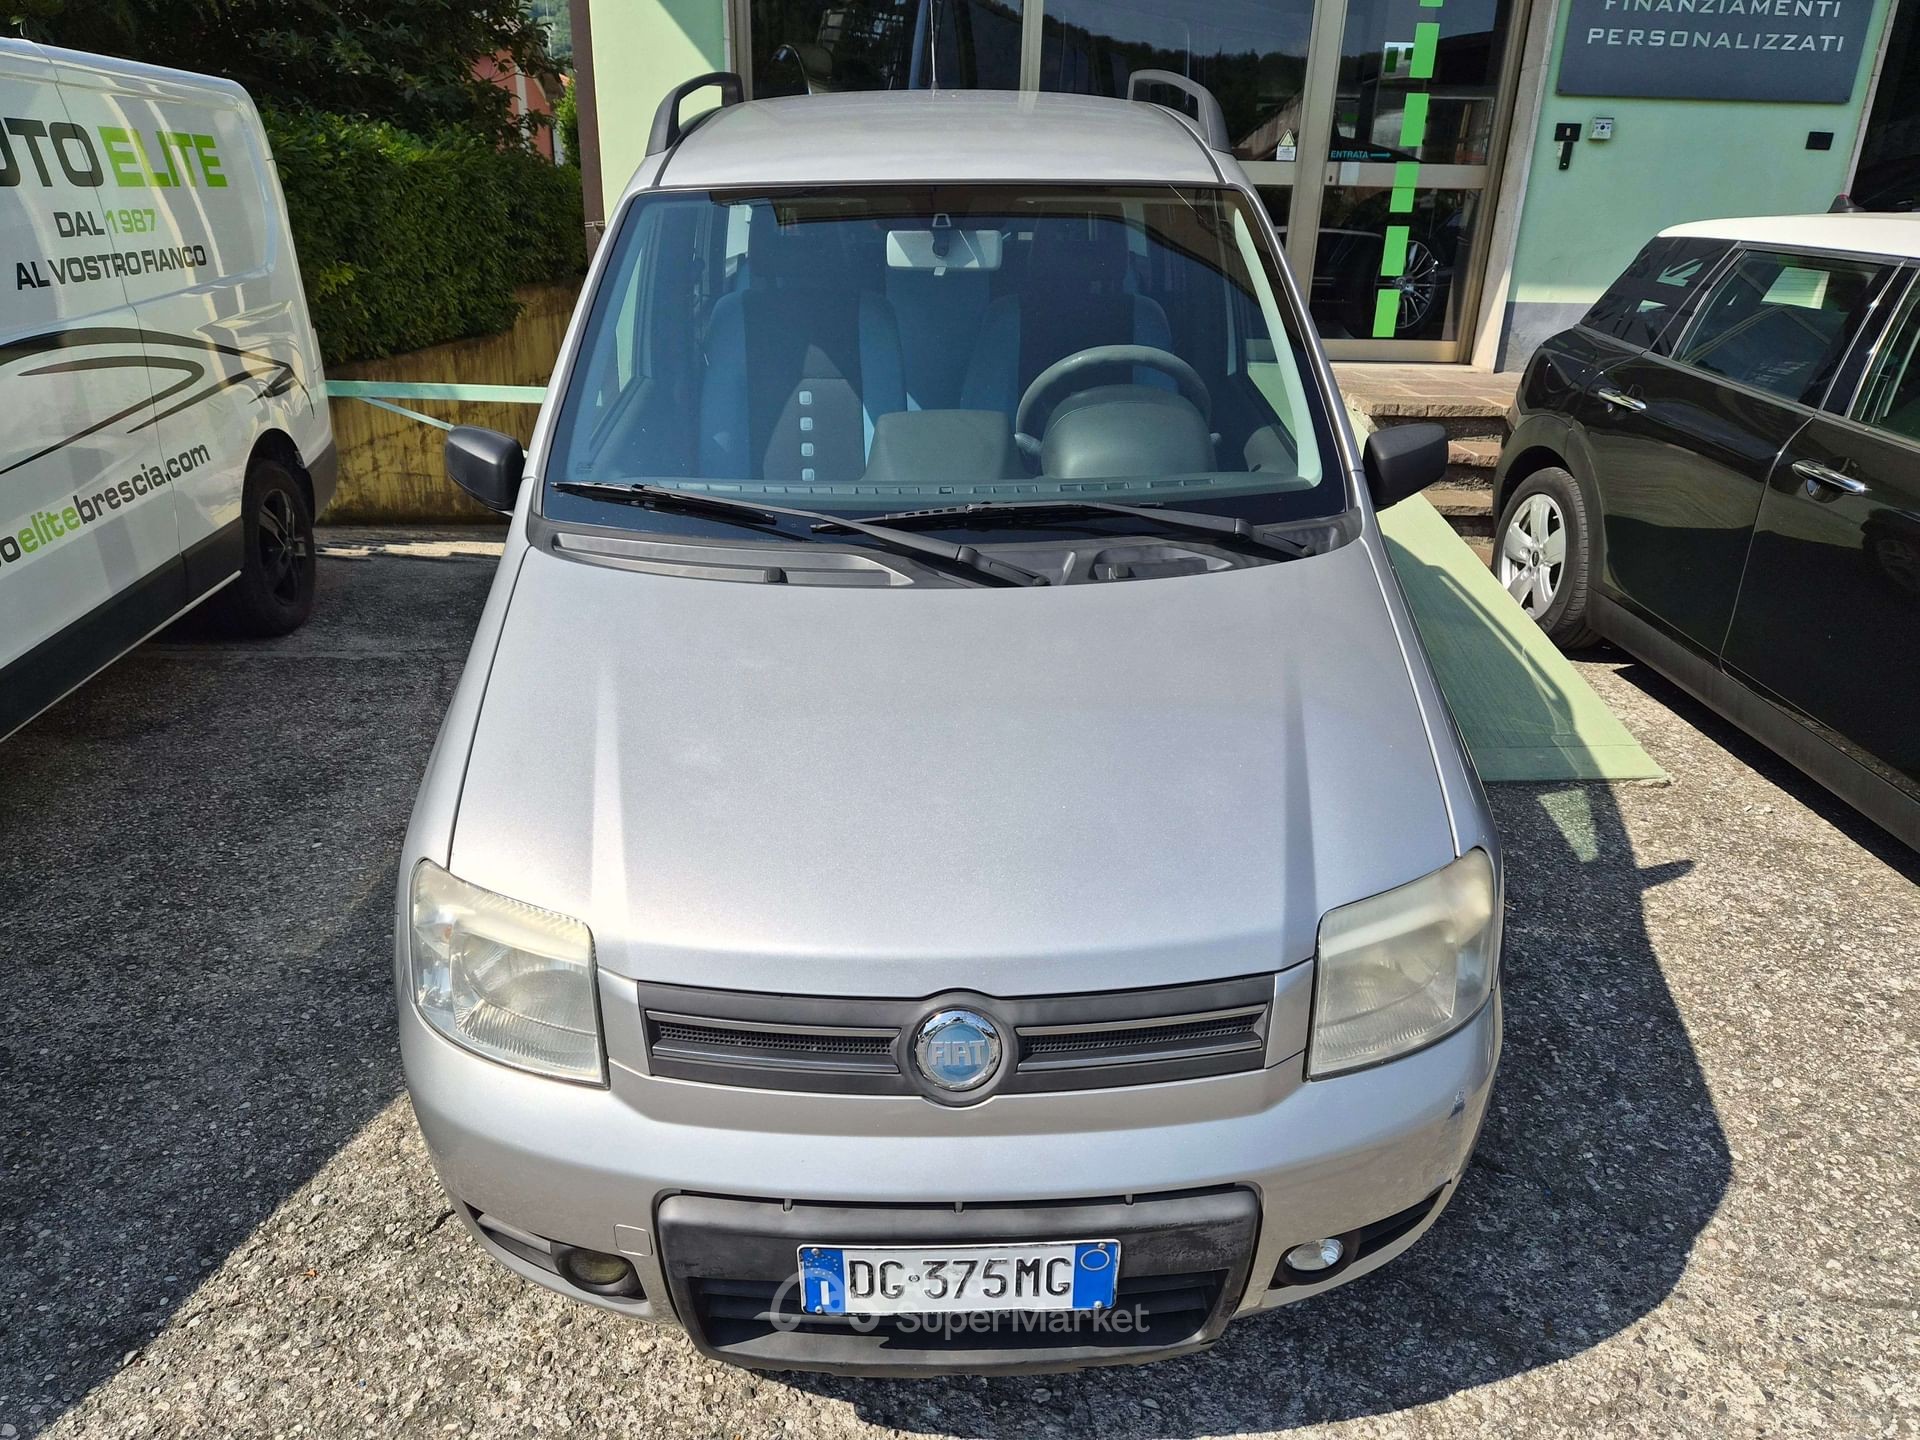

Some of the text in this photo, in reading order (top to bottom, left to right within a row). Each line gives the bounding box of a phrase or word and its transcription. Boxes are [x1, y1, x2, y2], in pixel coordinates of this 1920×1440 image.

[1604, 0, 1841, 18] FINANZIAMENTI
[1586, 28, 1845, 52] PERSONALIZZATI
[97, 126, 228, 187] ELITE
[1330, 150, 1369, 159] ENTRATA
[53, 209, 156, 238] DAL 1987
[16, 245, 207, 290] AL VOSTRO FIANCO
[0, 444, 211, 568] oelitebrescia.com
[930, 1040, 985, 1066] FIAT
[848, 1259, 905, 1299] DG
